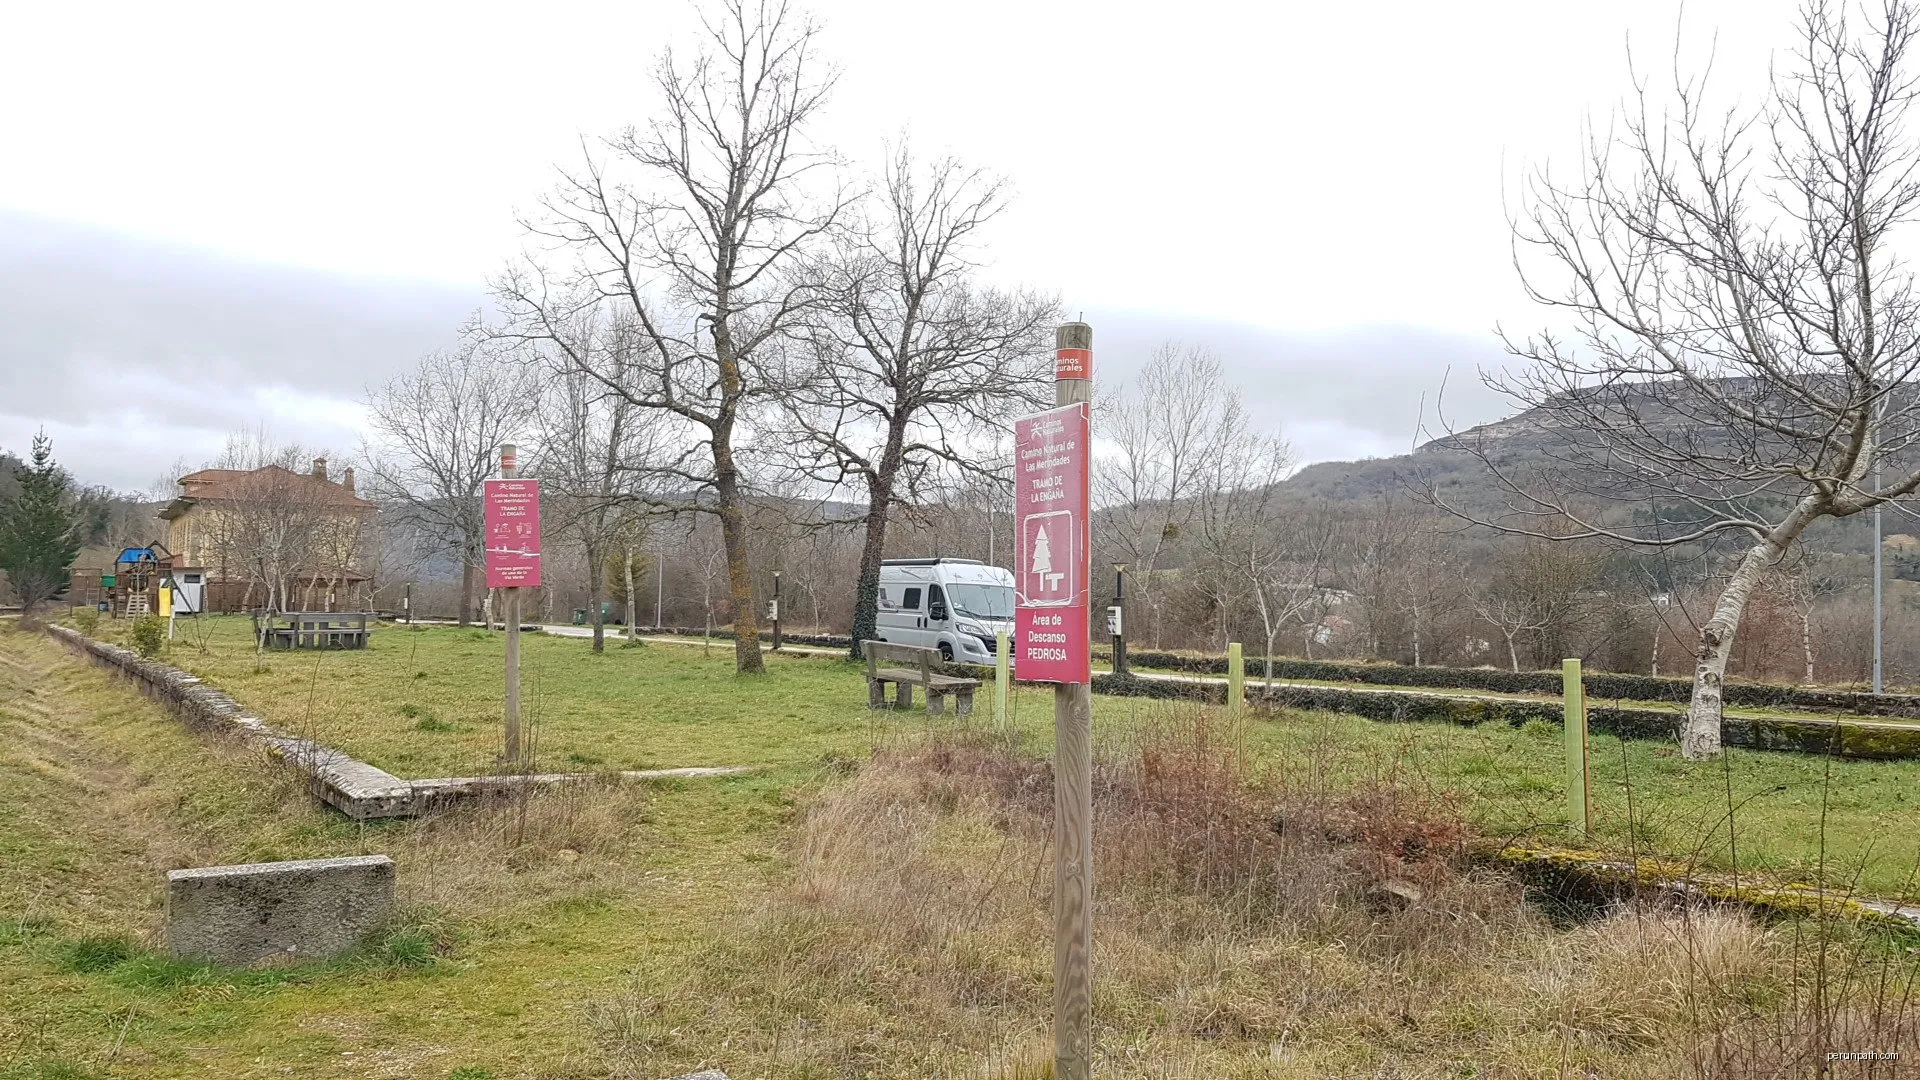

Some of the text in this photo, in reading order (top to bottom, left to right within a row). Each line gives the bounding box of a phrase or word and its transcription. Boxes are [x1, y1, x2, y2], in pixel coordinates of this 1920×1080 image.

[1021, 440, 1075, 460] Camino Natural de
[1025, 455, 1070, 472] Las Merindades
[1032, 475, 1063, 490] TRAMO DE
[1031, 487, 1065, 503] LA ENGAÑA
[1032, 611, 1062, 626] Área de
[1028, 630, 1066, 643] Descanso
[1027, 647, 1067, 661] PEDROSA
